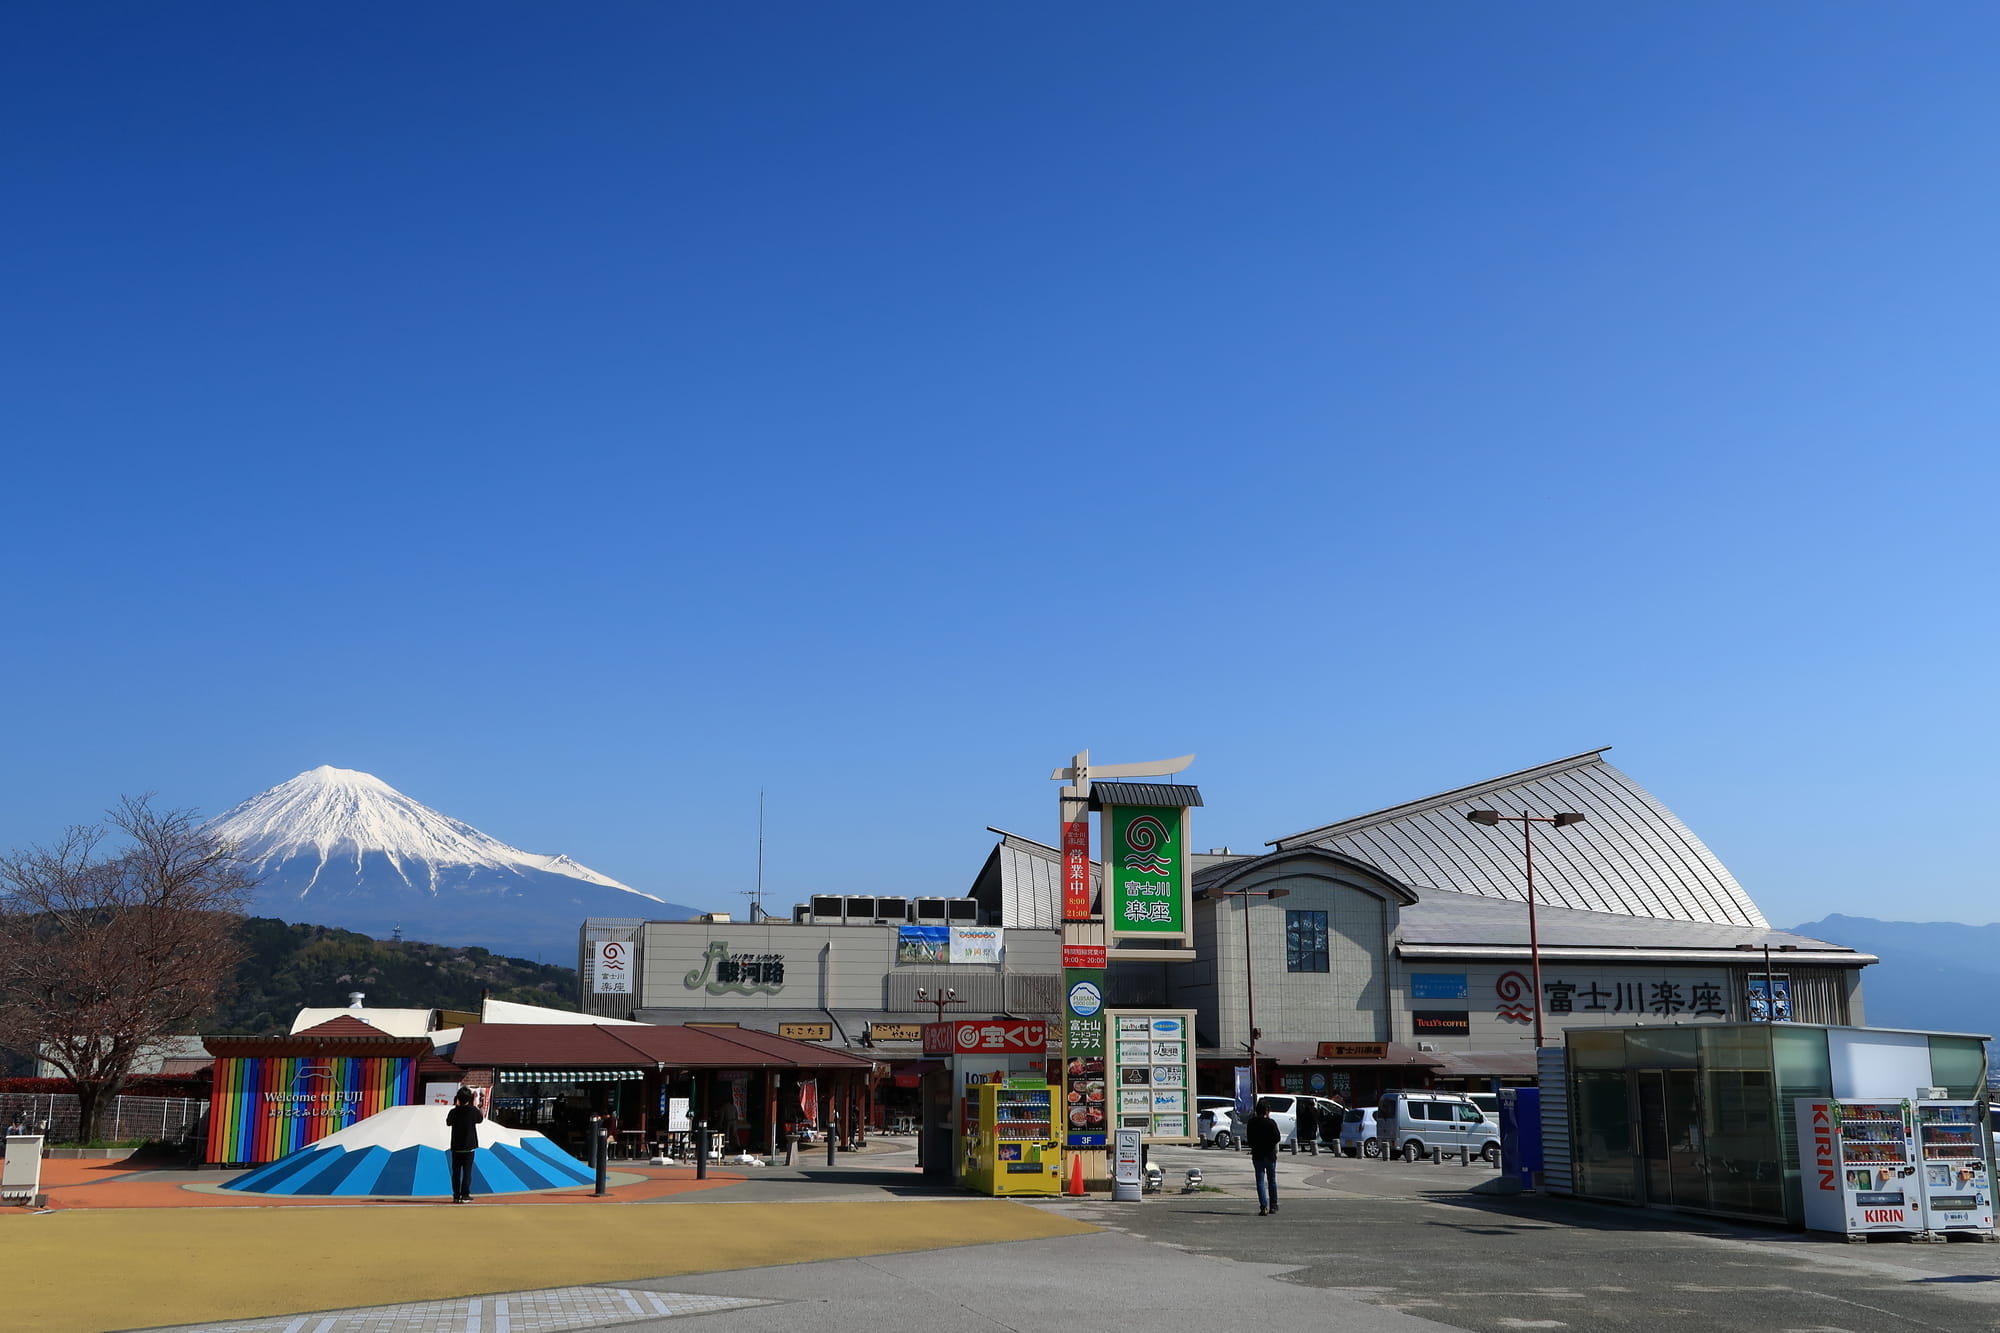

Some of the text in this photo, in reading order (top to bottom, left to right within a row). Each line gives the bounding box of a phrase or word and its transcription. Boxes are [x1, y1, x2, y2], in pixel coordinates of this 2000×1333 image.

[1069, 849, 1084, 895] 営業中
[1125, 881, 1170, 897] 富士川
[1124, 900, 1172, 922] 楽座
[601, 972, 625, 980] 富士川
[718, 961, 784, 983] 駿河路
[601, 982, 625, 992] 楽座
[1544, 980, 1726, 1016] 富士川楽座
[785, 1026, 825, 1035] おこたま
[875, 1024, 902, 1032] たこやき
[1070, 1020, 1101, 1031] 富士山
[980, 1025, 1044, 1048] 宝くじ
[1070, 1038, 1101, 1048] テラス
[1336, 1046, 1383, 1055] 富士川楽座
[264, 1091, 363, 1104] Welcome to FUJI
[1081, 1136, 1092, 1145] 3F
[1811, 1104, 1836, 1191] KIRIN
[1864, 1209, 1904, 1223] KIRIN
